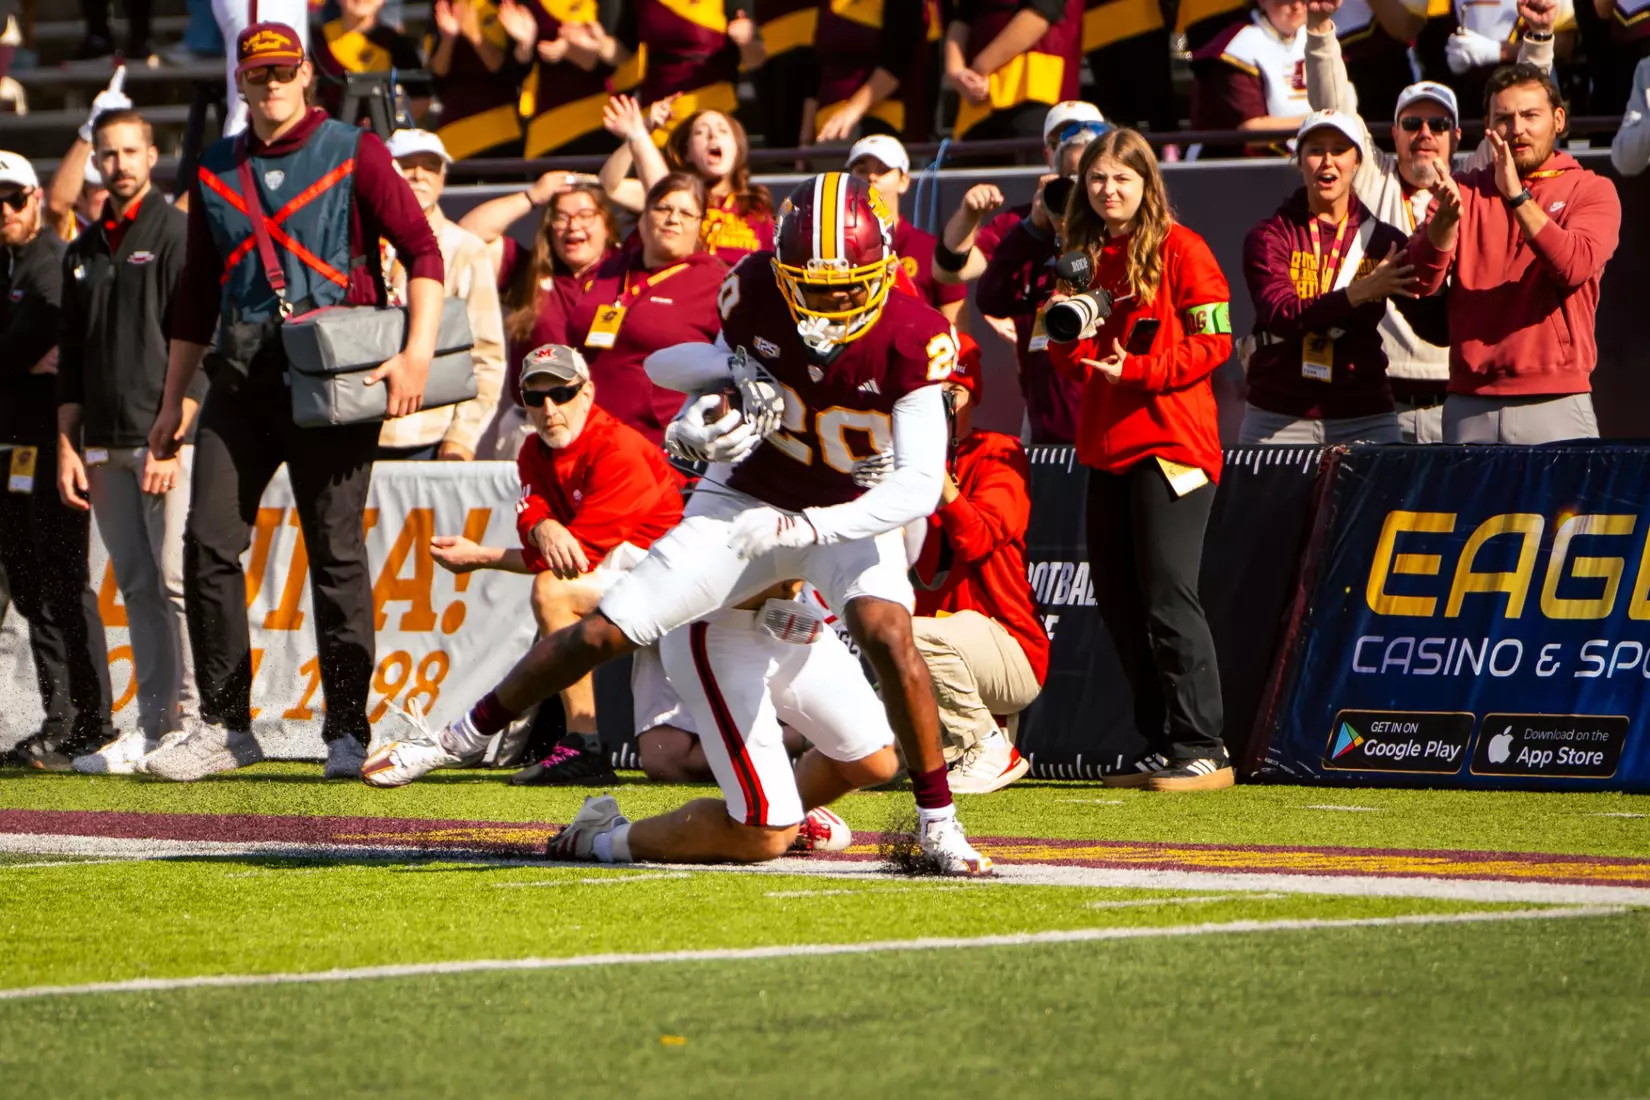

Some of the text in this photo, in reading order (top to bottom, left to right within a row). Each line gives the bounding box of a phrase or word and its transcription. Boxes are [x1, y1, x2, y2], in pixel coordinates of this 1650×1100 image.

[1352, 635, 1650, 678] CASINO & SP
[1370, 721, 1419, 733] GET IN ON
[1523, 728, 1609, 742] Download on the
[1364, 739, 1461, 762] Google Play
[1515, 746, 1604, 768] App Store
